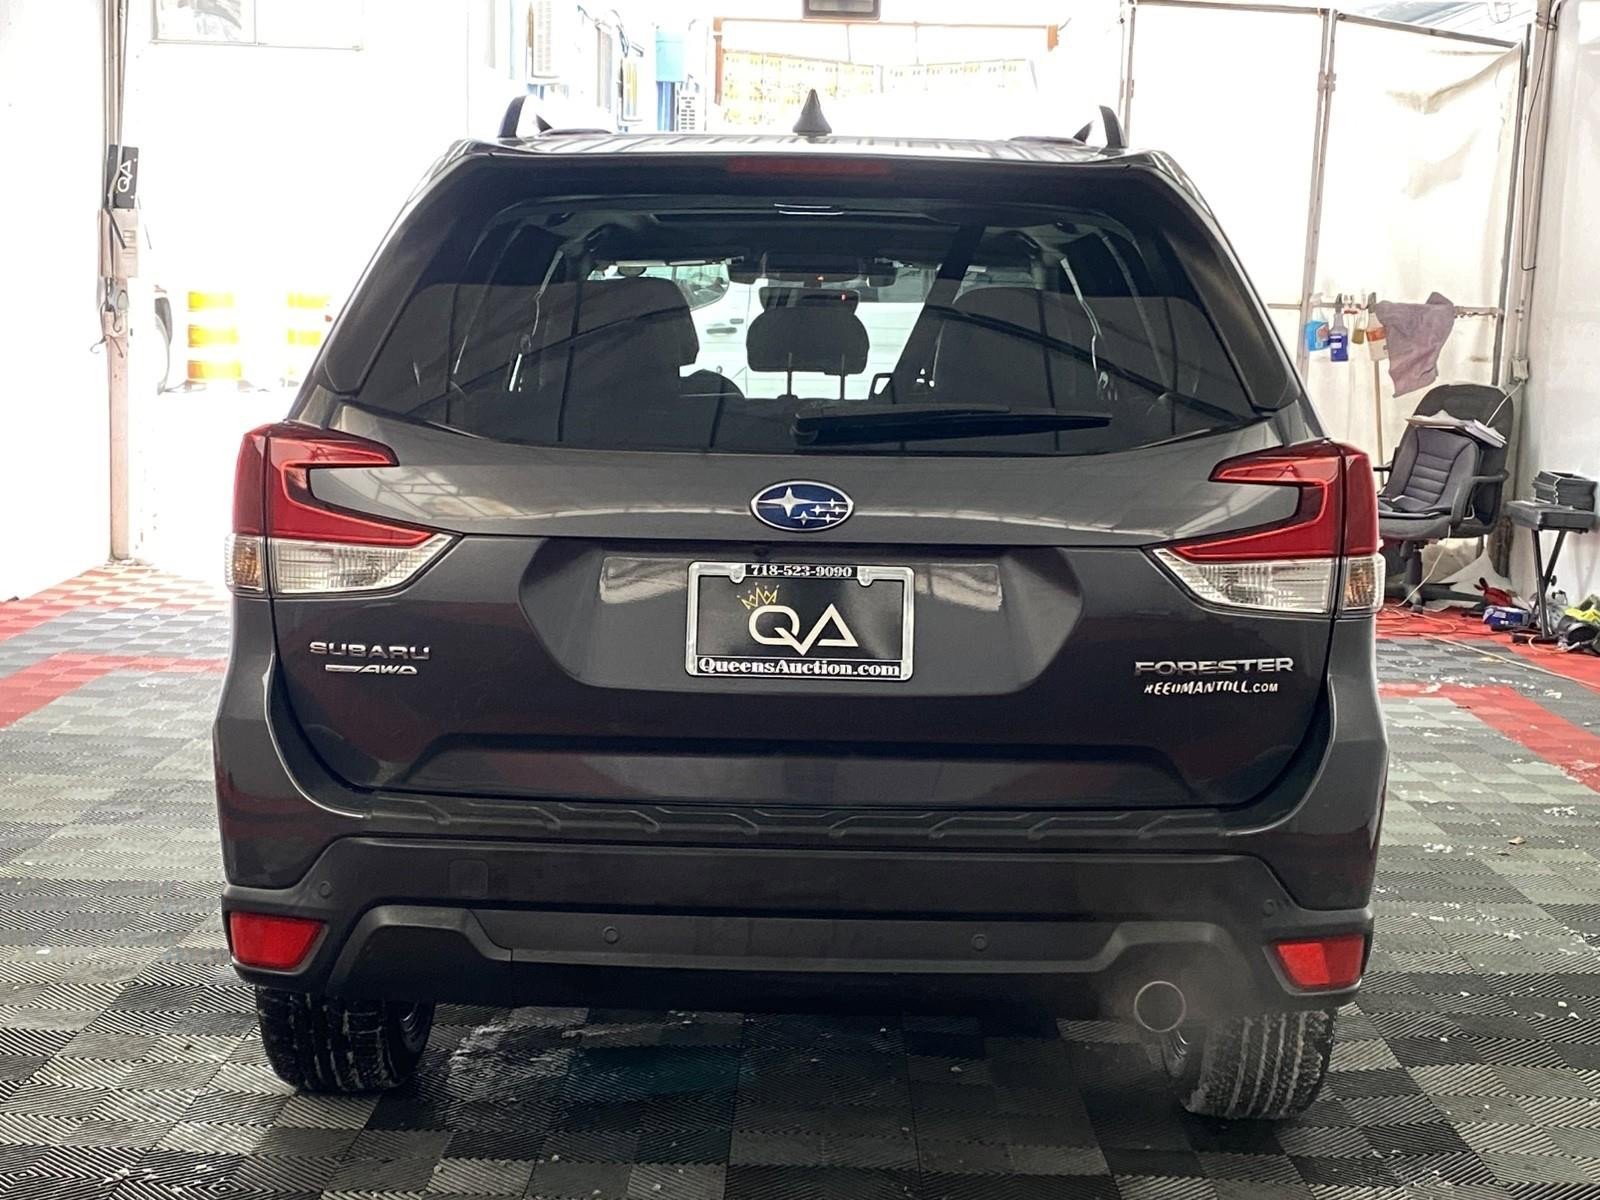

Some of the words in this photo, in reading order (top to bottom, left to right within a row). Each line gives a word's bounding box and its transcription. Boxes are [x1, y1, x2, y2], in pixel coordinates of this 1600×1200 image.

[751, 564, 852, 577] 718-523-9090
[309, 641, 430, 660] SUBARU
[360, 664, 418, 675] AWD
[699, 657, 900, 676] QueensAuction.com
[1134, 657, 1294, 676] FORESTER
